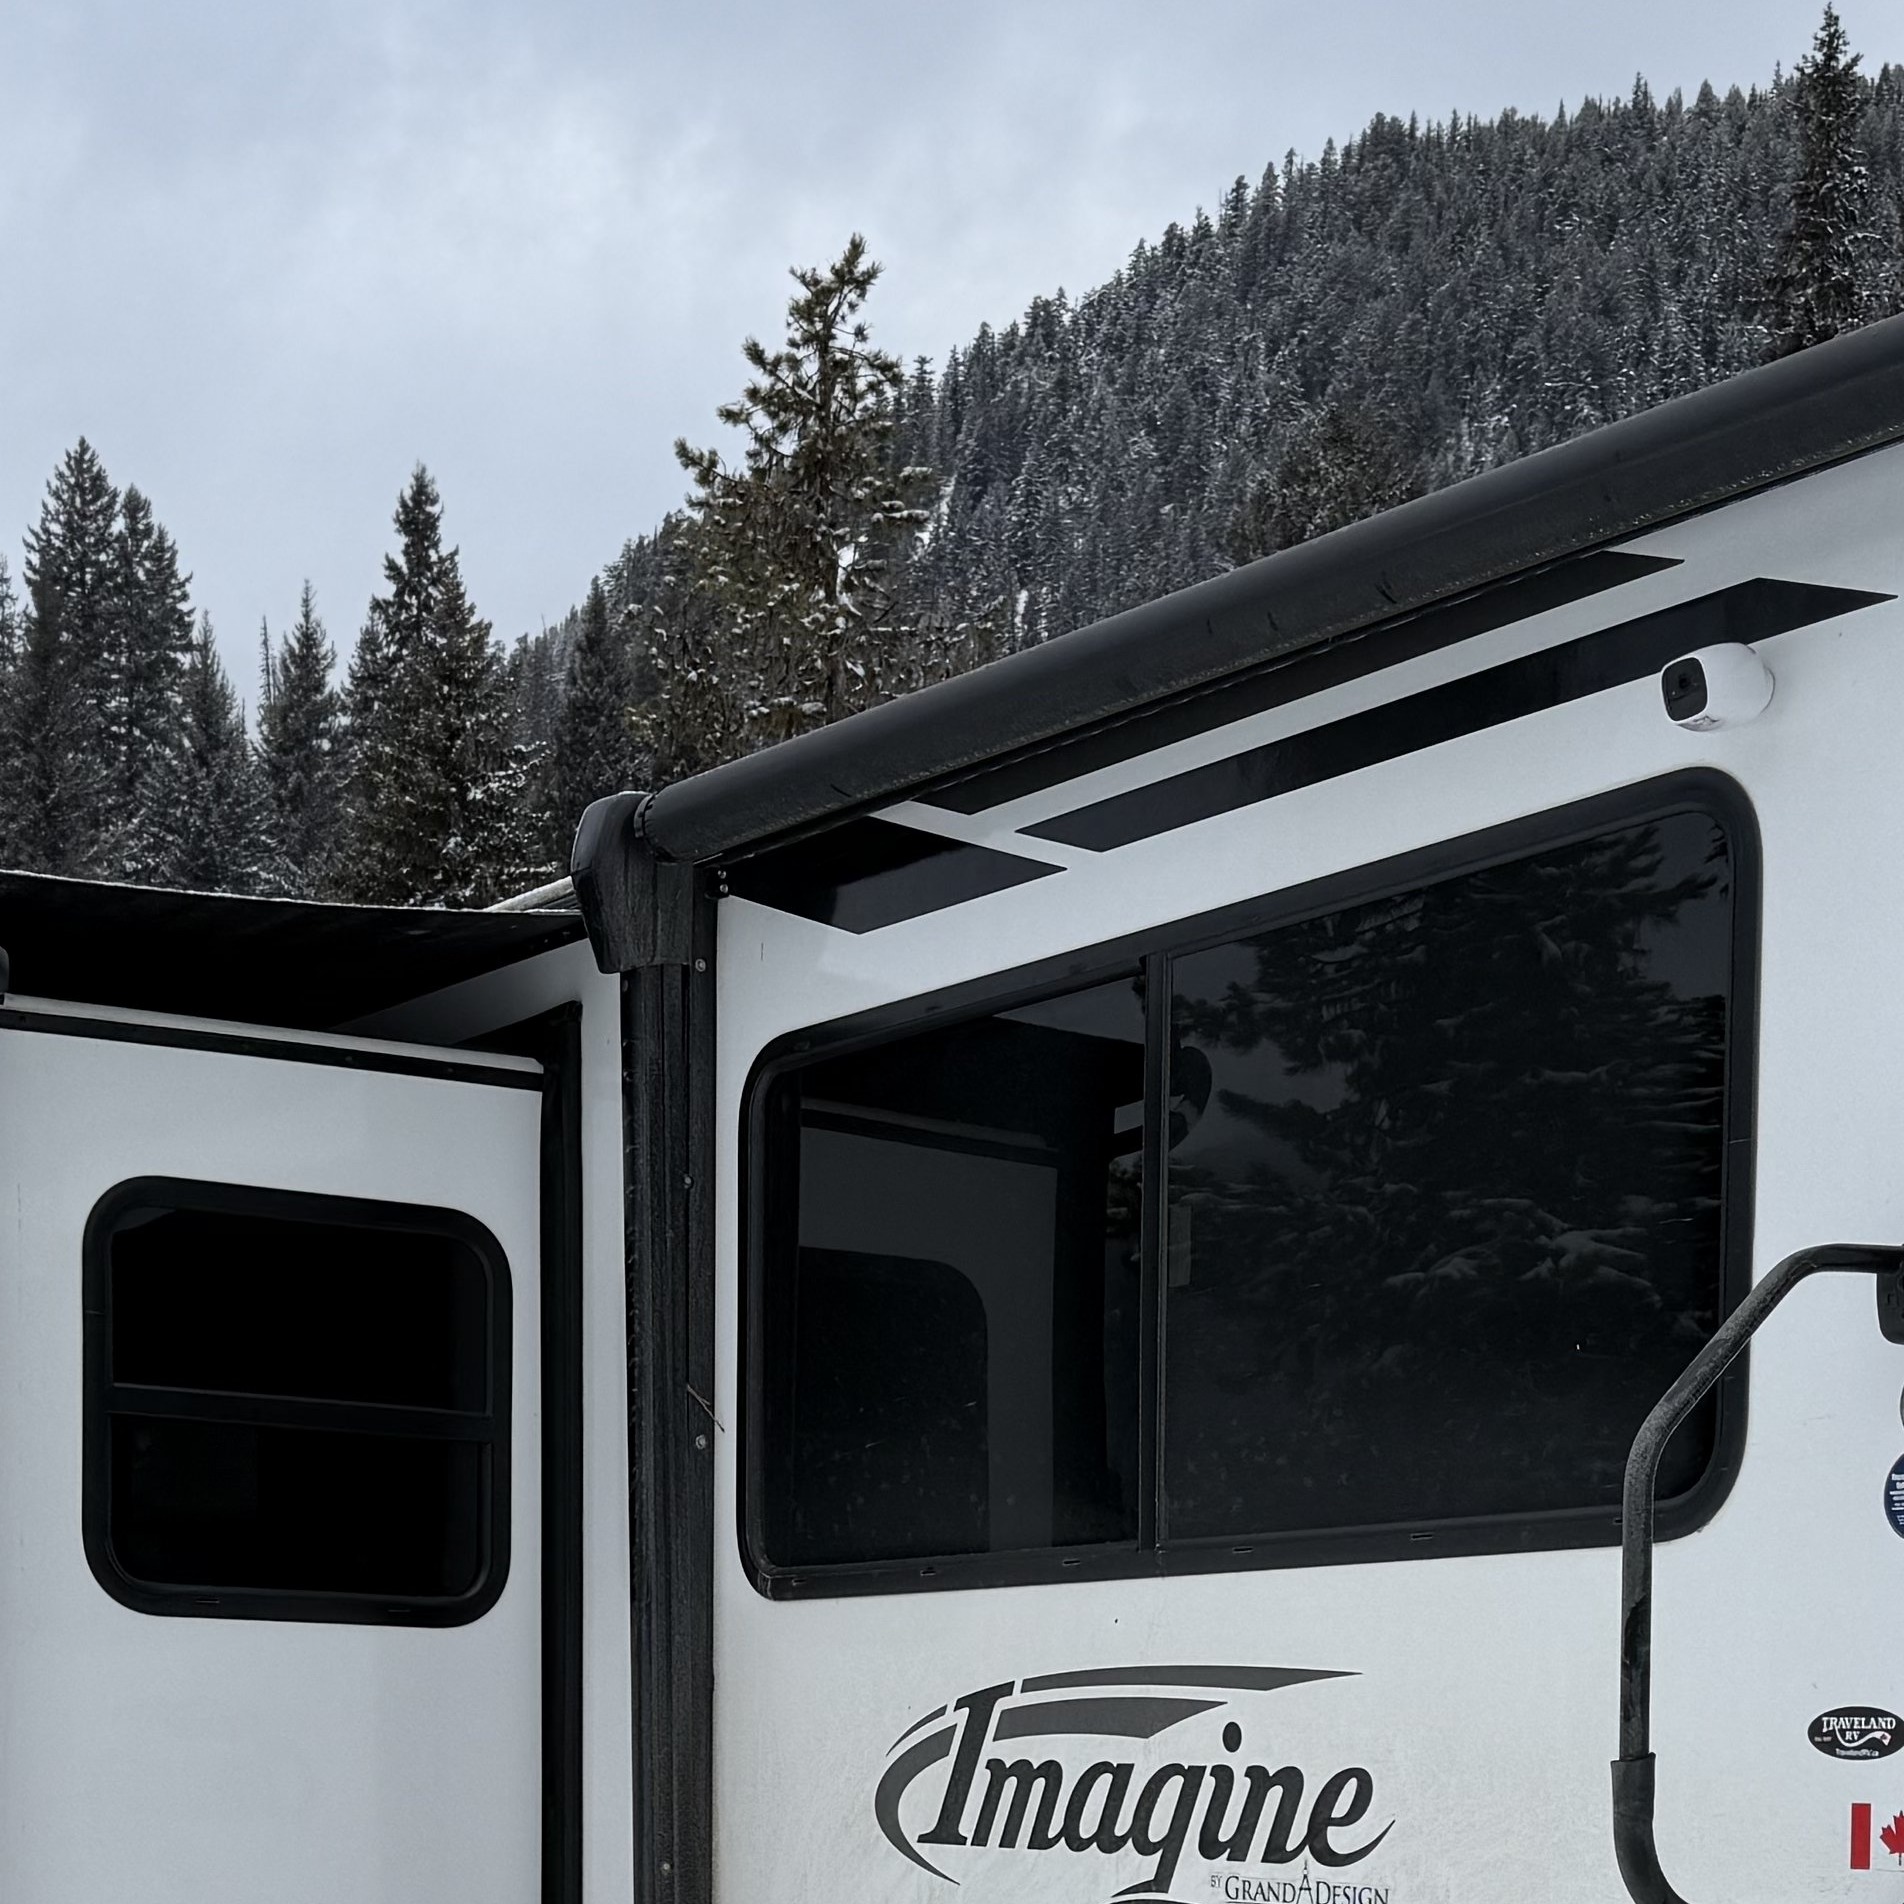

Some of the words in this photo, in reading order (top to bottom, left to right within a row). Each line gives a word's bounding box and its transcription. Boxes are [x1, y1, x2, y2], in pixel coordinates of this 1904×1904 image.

[1822, 1716, 1897, 1733] TRAVELAND
[1845, 1731, 1861, 1741] RV
[1225, 1875, 1296, 1904] GRAND
